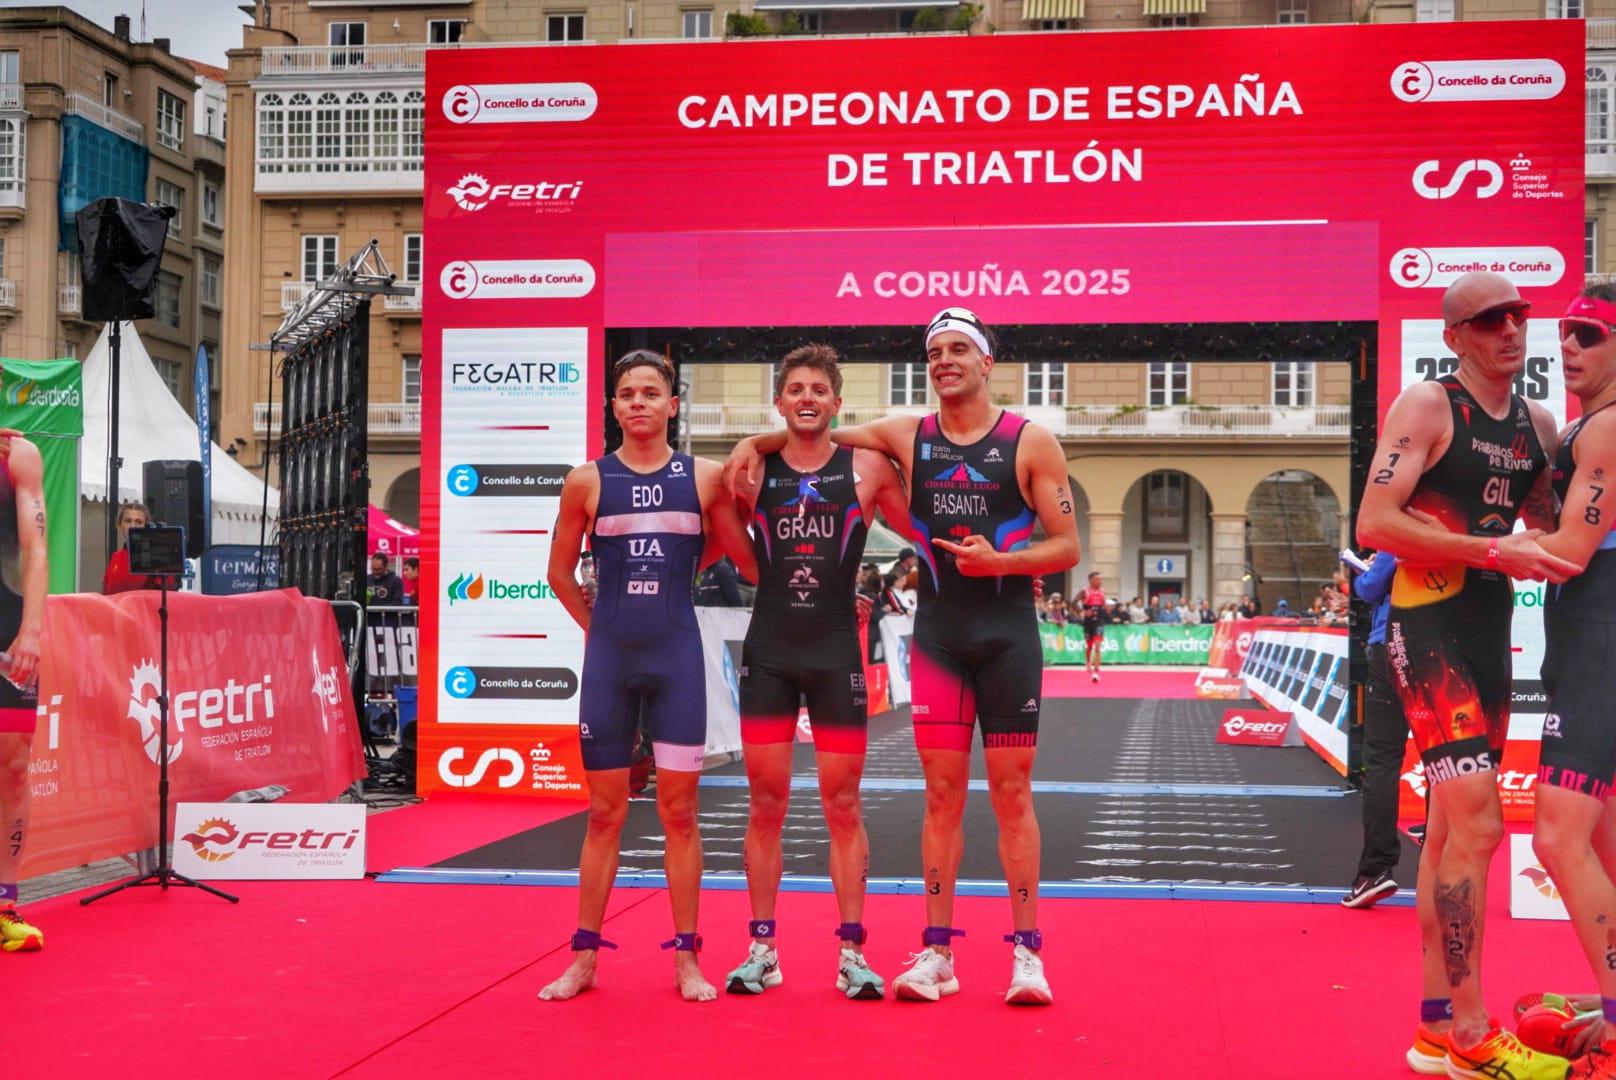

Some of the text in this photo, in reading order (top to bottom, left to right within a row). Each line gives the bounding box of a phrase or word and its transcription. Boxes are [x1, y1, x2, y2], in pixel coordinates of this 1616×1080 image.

[1438, 74, 1552, 86] Concello da Coruña
[484, 96, 586, 109] Concello da Coruña
[678, 73, 1304, 128] CAMPEONATO DE ESPAÑA
[828, 139, 1143, 187] DE TRIATLÓN
[1512, 174, 1547, 183] Consejo
[1512, 182, 1549, 191] Superior
[1525, 190, 1564, 198] Deportes
[1437, 261, 1552, 273] Concello da Coruña
[482, 272, 584, 285] Concello da Coruña
[836, 263, 1131, 297] A CORUÑA 2025
[482, 476, 565, 485] Concello da Coruñ
[632, 484, 663, 507] EDO
[1483, 476, 1514, 508] GIL
[933, 493, 989, 516] BASANTA
[1060, 500, 1072, 514] 3
[776, 515, 834, 539] GRAU
[628, 538, 665, 556] UA
[489, 580, 557, 599] Iberdr
[1151, 637, 1213, 652] Iberdro
[481, 679, 569, 689] Concello da Coruña
[533, 764, 565, 774] Consejo
[533, 773, 567, 781] Superior
[533, 781, 581, 790] de Deportes
